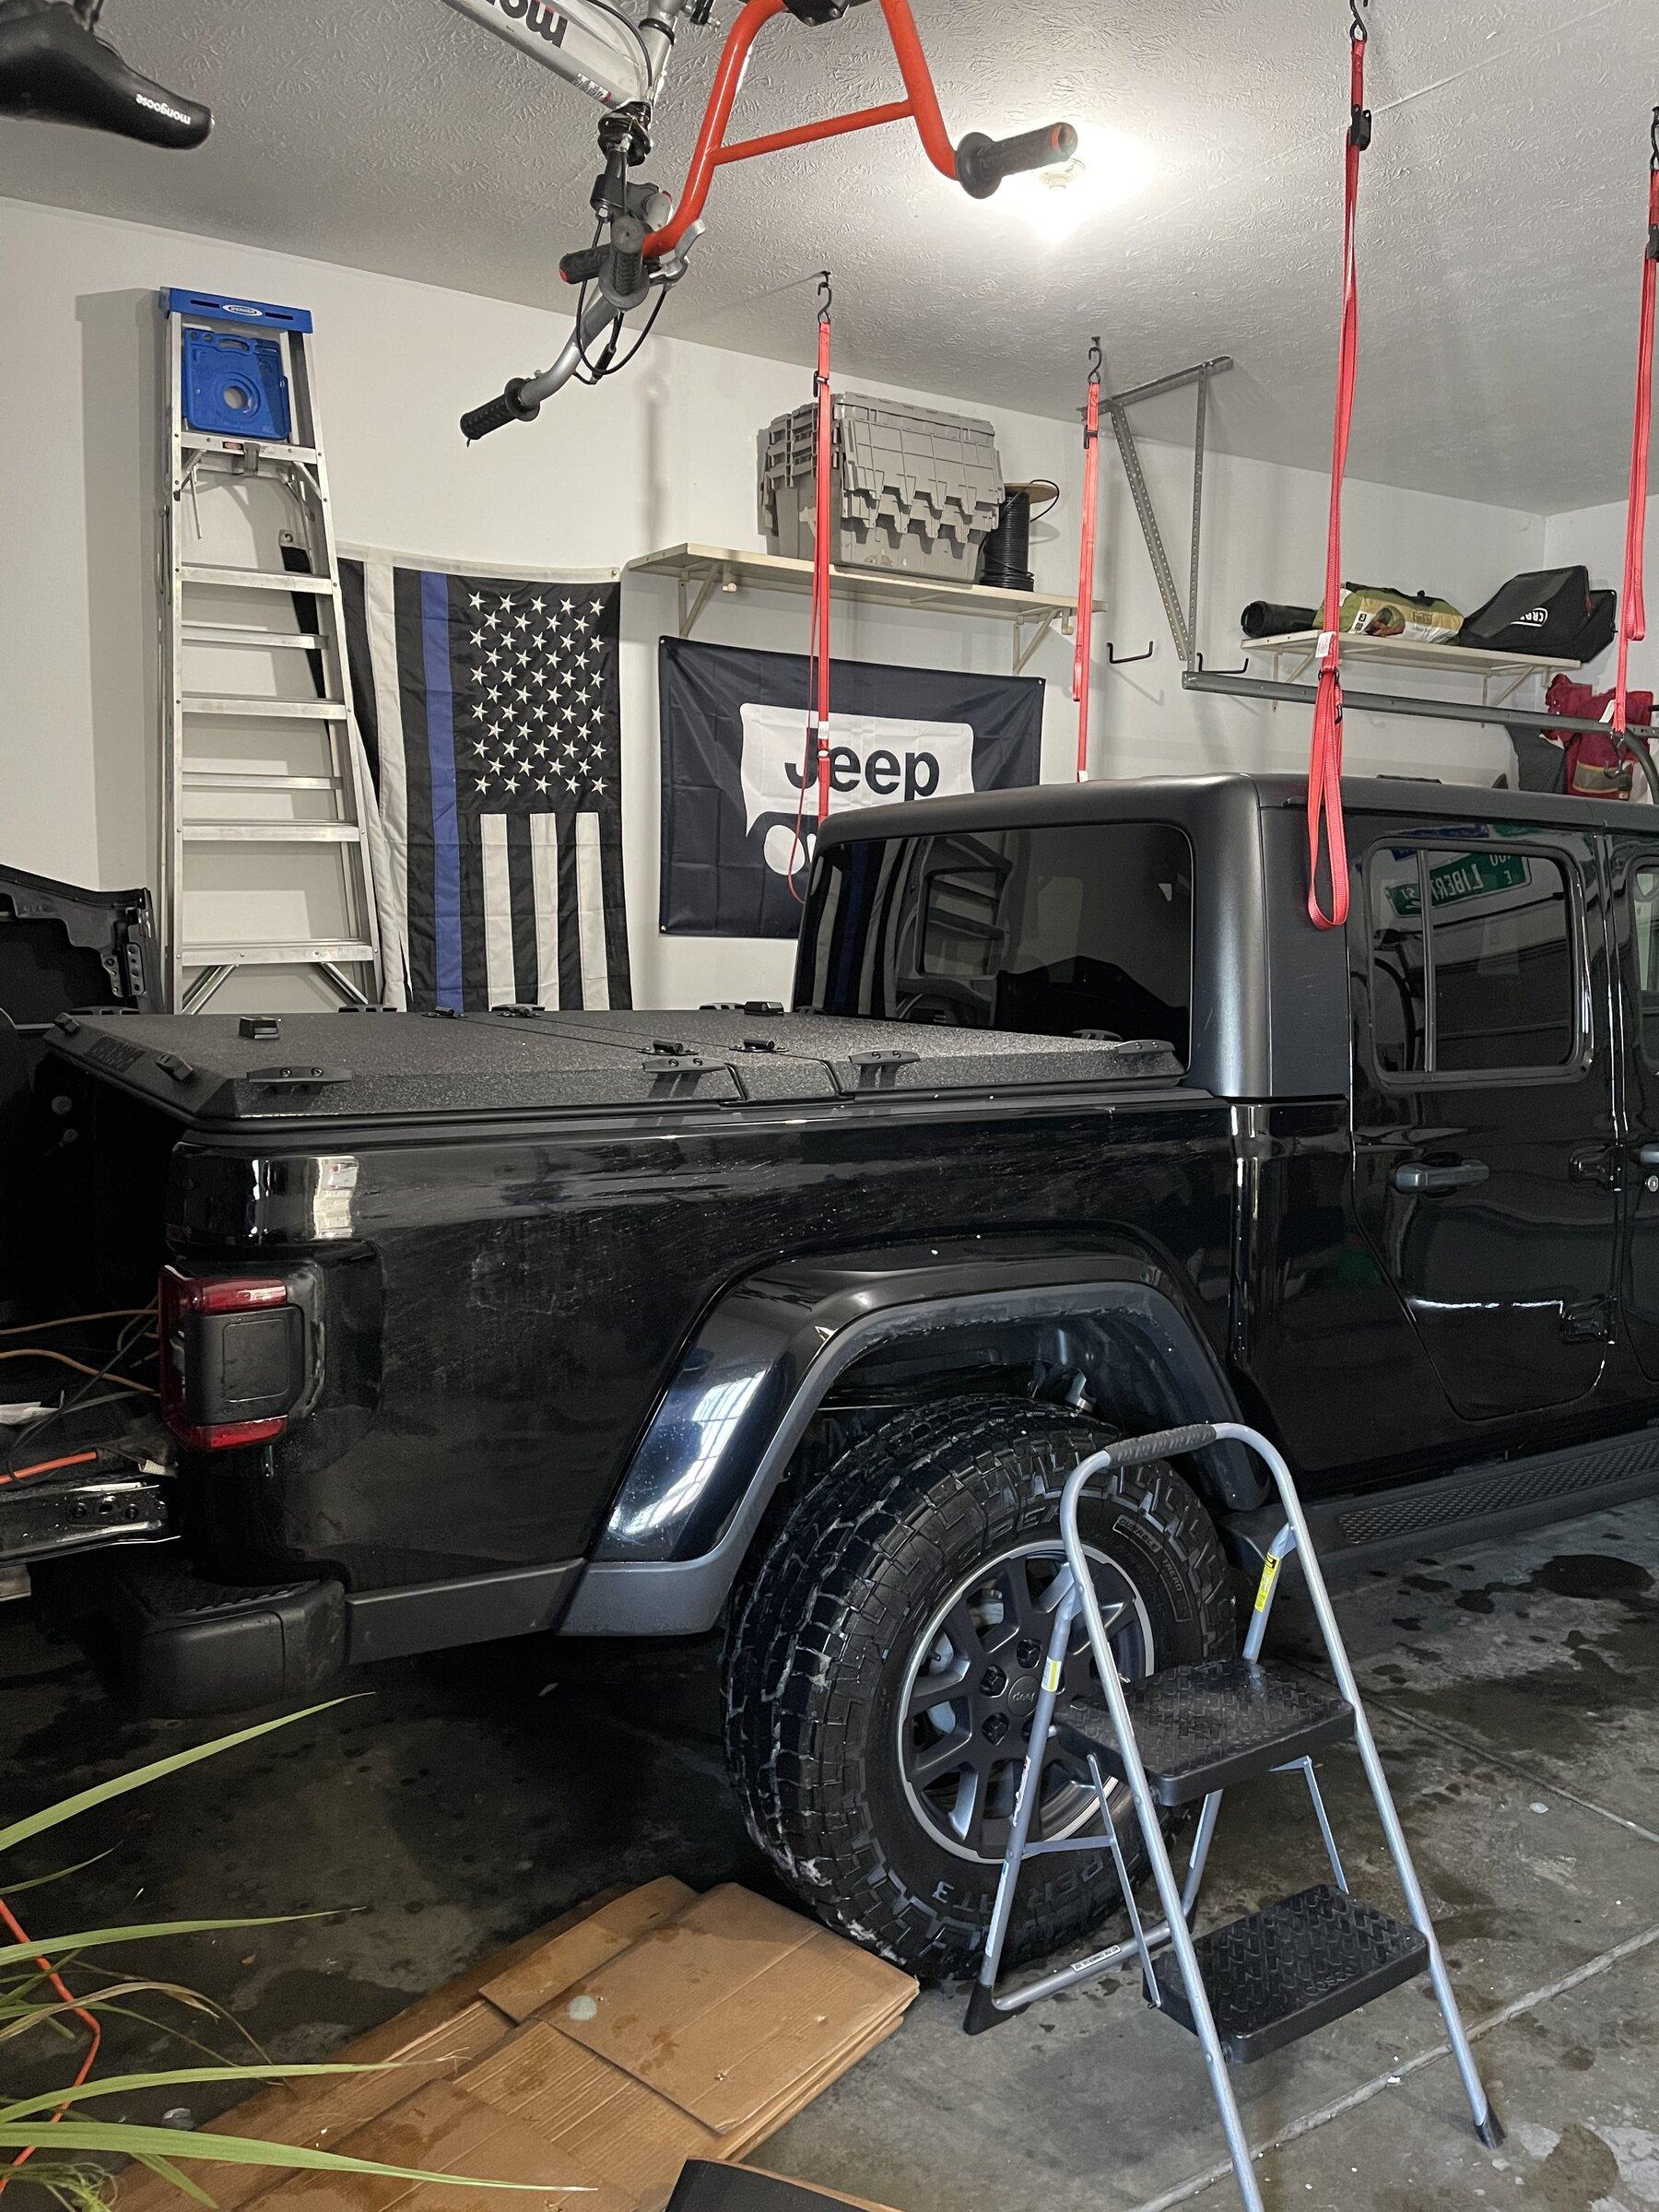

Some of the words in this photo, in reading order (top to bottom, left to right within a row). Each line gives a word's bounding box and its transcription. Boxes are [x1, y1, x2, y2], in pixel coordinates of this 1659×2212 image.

[487, 0, 568, 48] mo
[135, 93, 191, 125] mongoose
[784, 727, 940, 802] Jeep
